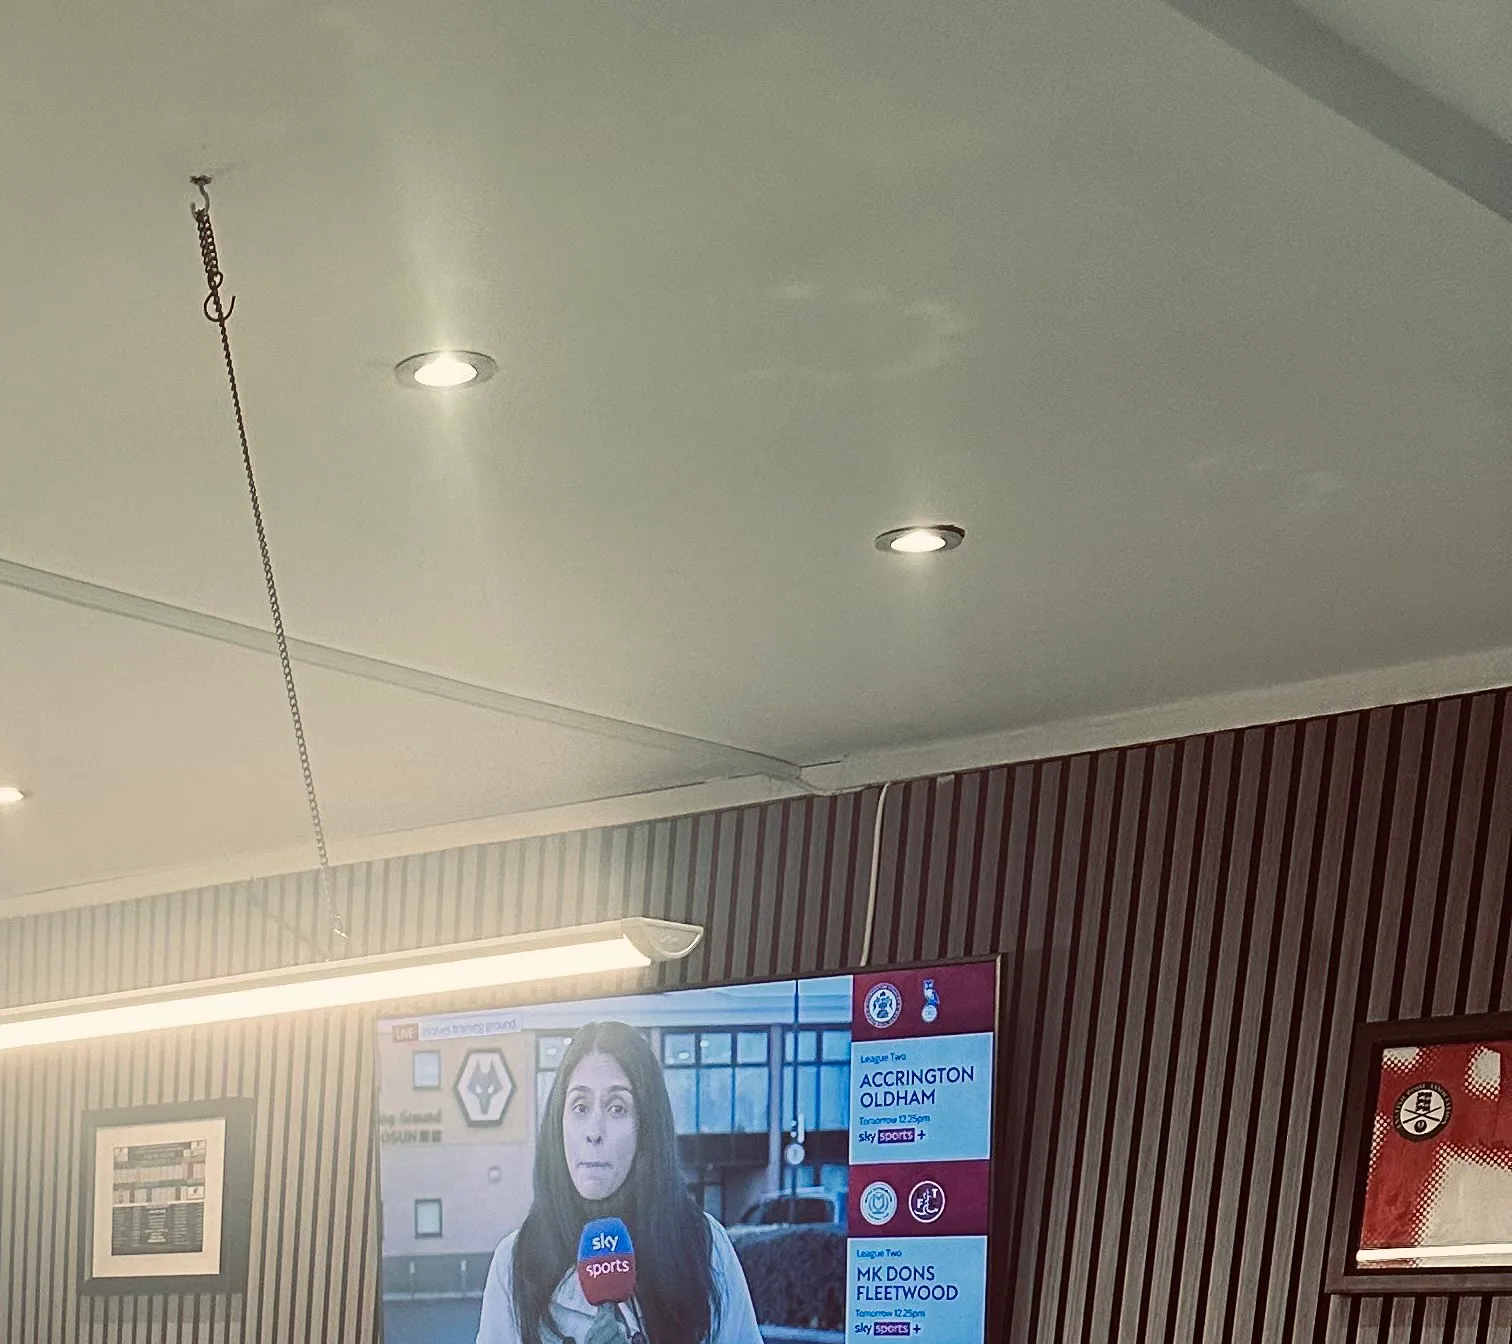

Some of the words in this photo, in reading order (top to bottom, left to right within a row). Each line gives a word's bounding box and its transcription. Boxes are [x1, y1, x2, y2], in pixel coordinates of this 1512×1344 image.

[860, 1054, 888, 1065] League
[890, 1052, 907, 1062] Two
[859, 1065, 974, 1088] ACCRINGTON
[860, 1089, 936, 1108] OLDHAM
[859, 1116, 897, 1126] Tomorrow
[859, 1130, 876, 1144] sky
[879, 1129, 914, 1143] sports
[592, 1232, 619, 1252] sky
[857, 1250, 884, 1259] League
[886, 1249, 902, 1257] Two
[586, 1259, 629, 1278] sports
[857, 1266, 883, 1282] MK
[887, 1266, 935, 1281] DONS
[856, 1285, 958, 1301] FLEETWOOD
[855, 1309, 893, 1317] Tomorrow
[854, 1322, 872, 1335] sky
[875, 1323, 909, 1334] sports
